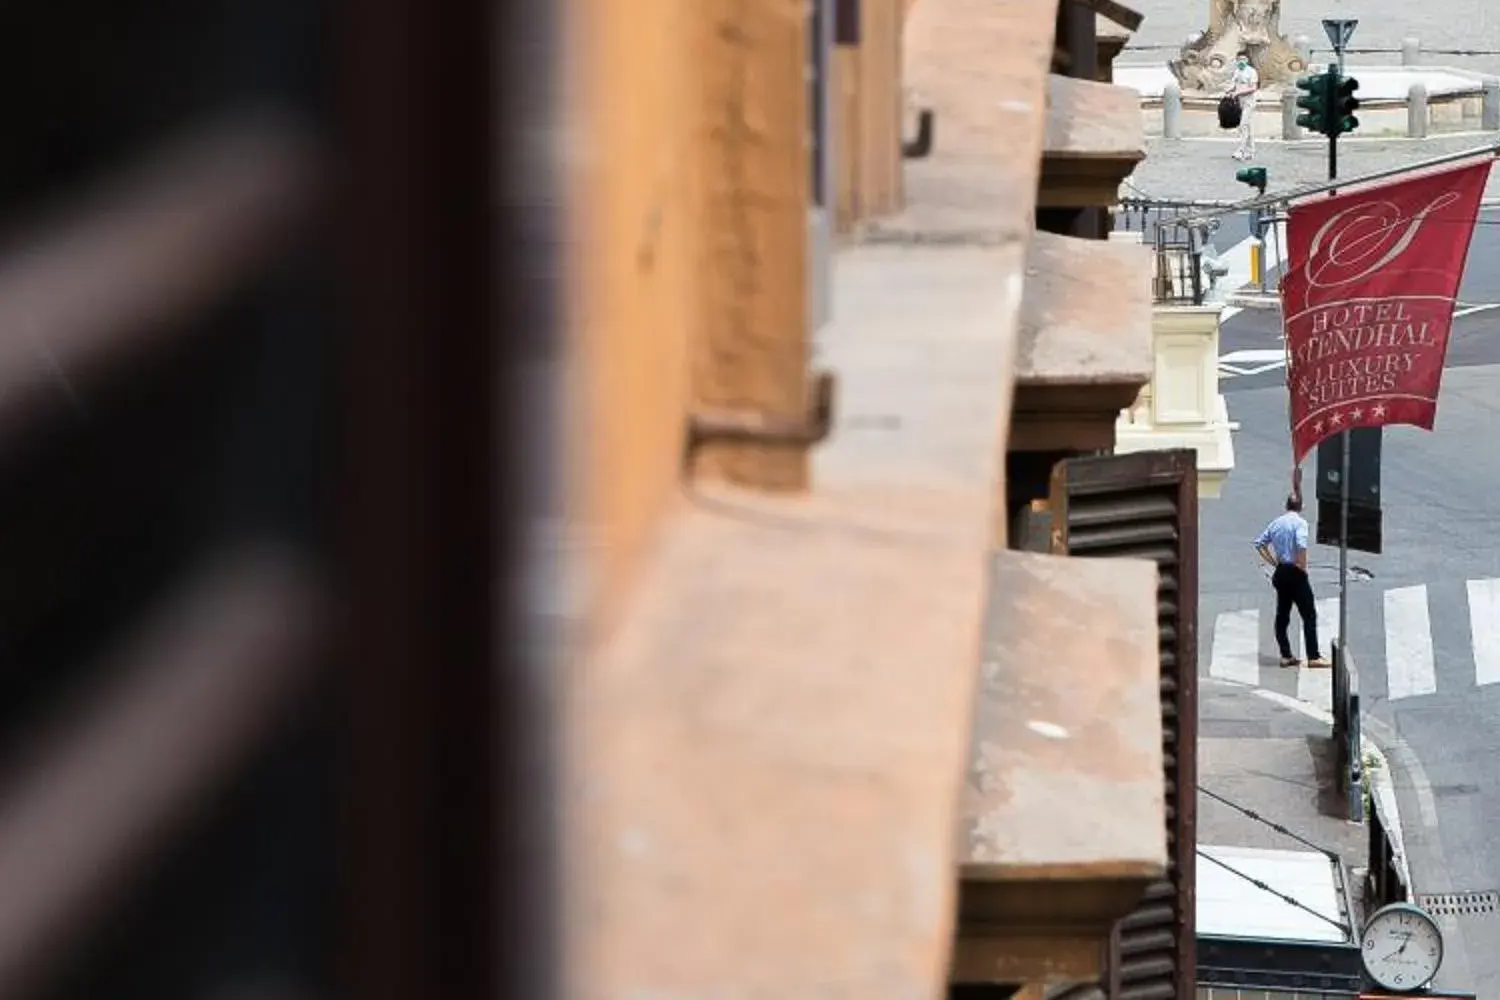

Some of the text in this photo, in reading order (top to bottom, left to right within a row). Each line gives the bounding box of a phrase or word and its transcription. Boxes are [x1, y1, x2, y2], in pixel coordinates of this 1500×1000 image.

[1312, 303, 1411, 334] HOTEL
[1297, 322, 1436, 362] STENDHAL
[1315, 353, 1421, 386] LUXURY
[1308, 373, 1397, 409] SUITES
